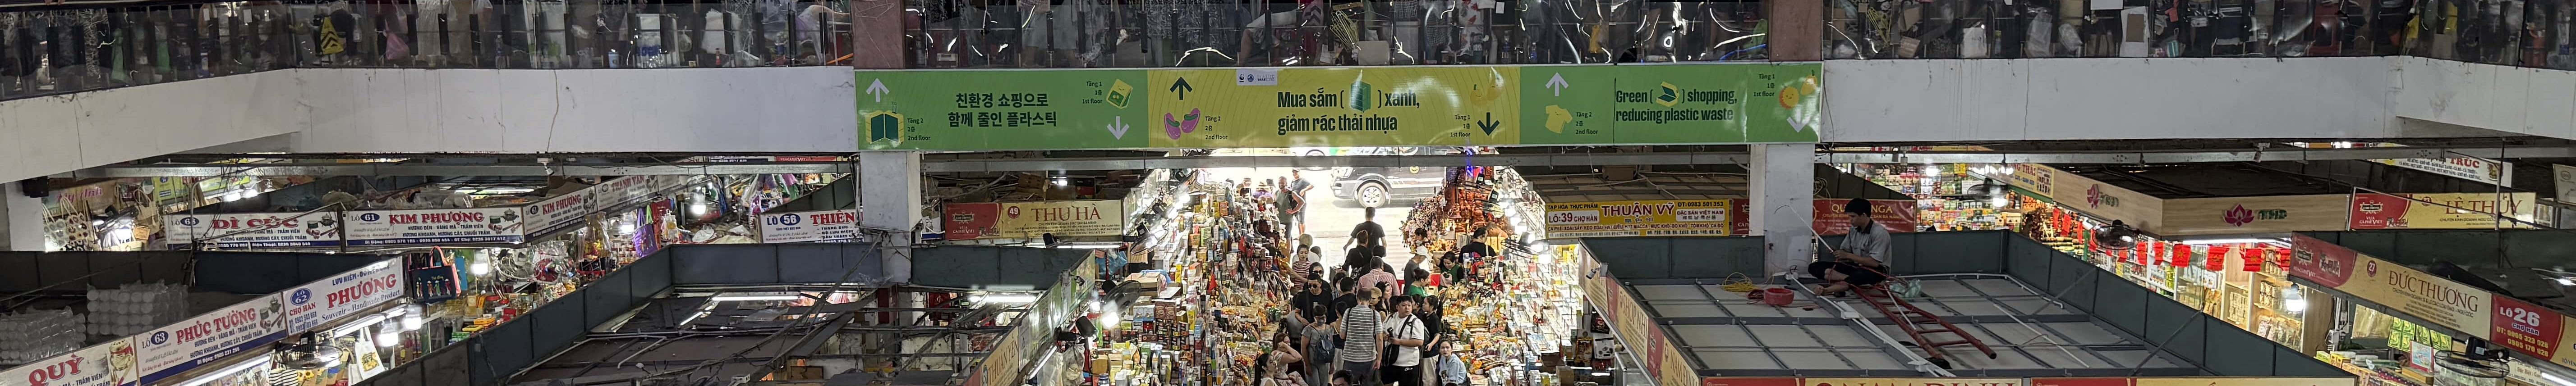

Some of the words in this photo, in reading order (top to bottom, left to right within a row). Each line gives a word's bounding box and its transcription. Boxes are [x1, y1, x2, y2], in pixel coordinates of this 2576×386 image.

[956, 93, 993, 108] 친환경
[998, 93, 1048, 108] 쇼핑으로
[1278, 92, 1306, 107] Mua
[1310, 87, 1337, 107] sắm
[1385, 90, 1419, 108] xanh,
[1616, 91, 1647, 103] Green
[1688, 89, 1737, 104] shopping,
[948, 112, 973, 127] 함께
[978, 112, 1002, 127] 줄인
[1007, 111, 1056, 127] 플라스틱
[1616, 109, 1662, 124] reducing
[1665, 108, 1698, 124] plastic
[1701, 108, 1733, 120] waste
[1278, 114, 1309, 135] giảm
[1313, 115, 1335, 131] rác
[1339, 114, 1362, 131] thải
[1366, 114, 1397, 134] nhựa
[543, 203, 555, 215] KIM
[1076, 203, 1103, 220] HÀ
[1601, 202, 1652, 217] THUẬN
[1656, 202, 1675, 215] VỸ
[1871, 204, 1893, 213] NGA
[390, 214, 419, 225] KIM
[422, 212, 484, 226] PHƯỢNG
[784, 215, 797, 224] 56
[810, 210, 855, 225] THIÊN
[1586, 214, 1598, 223] HÀN
[2369, 263, 2375, 272] 27
[327, 273, 397, 310] PHƯƠNG
[2389, 270, 2416, 293] ĐỨC
[2417, 278, 2479, 312] THƯƠNG
[295, 296, 308, 304] 62
[322, 309, 346, 322] Souvenir
[352, 298, 380, 311] Handmade
[381, 289, 400, 300] Product
[290, 307, 301, 316] CHỢ
[303, 301, 316, 312] HÀN
[2500, 307, 2512, 318] LÔ
[2513, 307, 2540, 327] 26
[155, 332, 165, 343] 63
[176, 320, 212, 345] PHÚC
